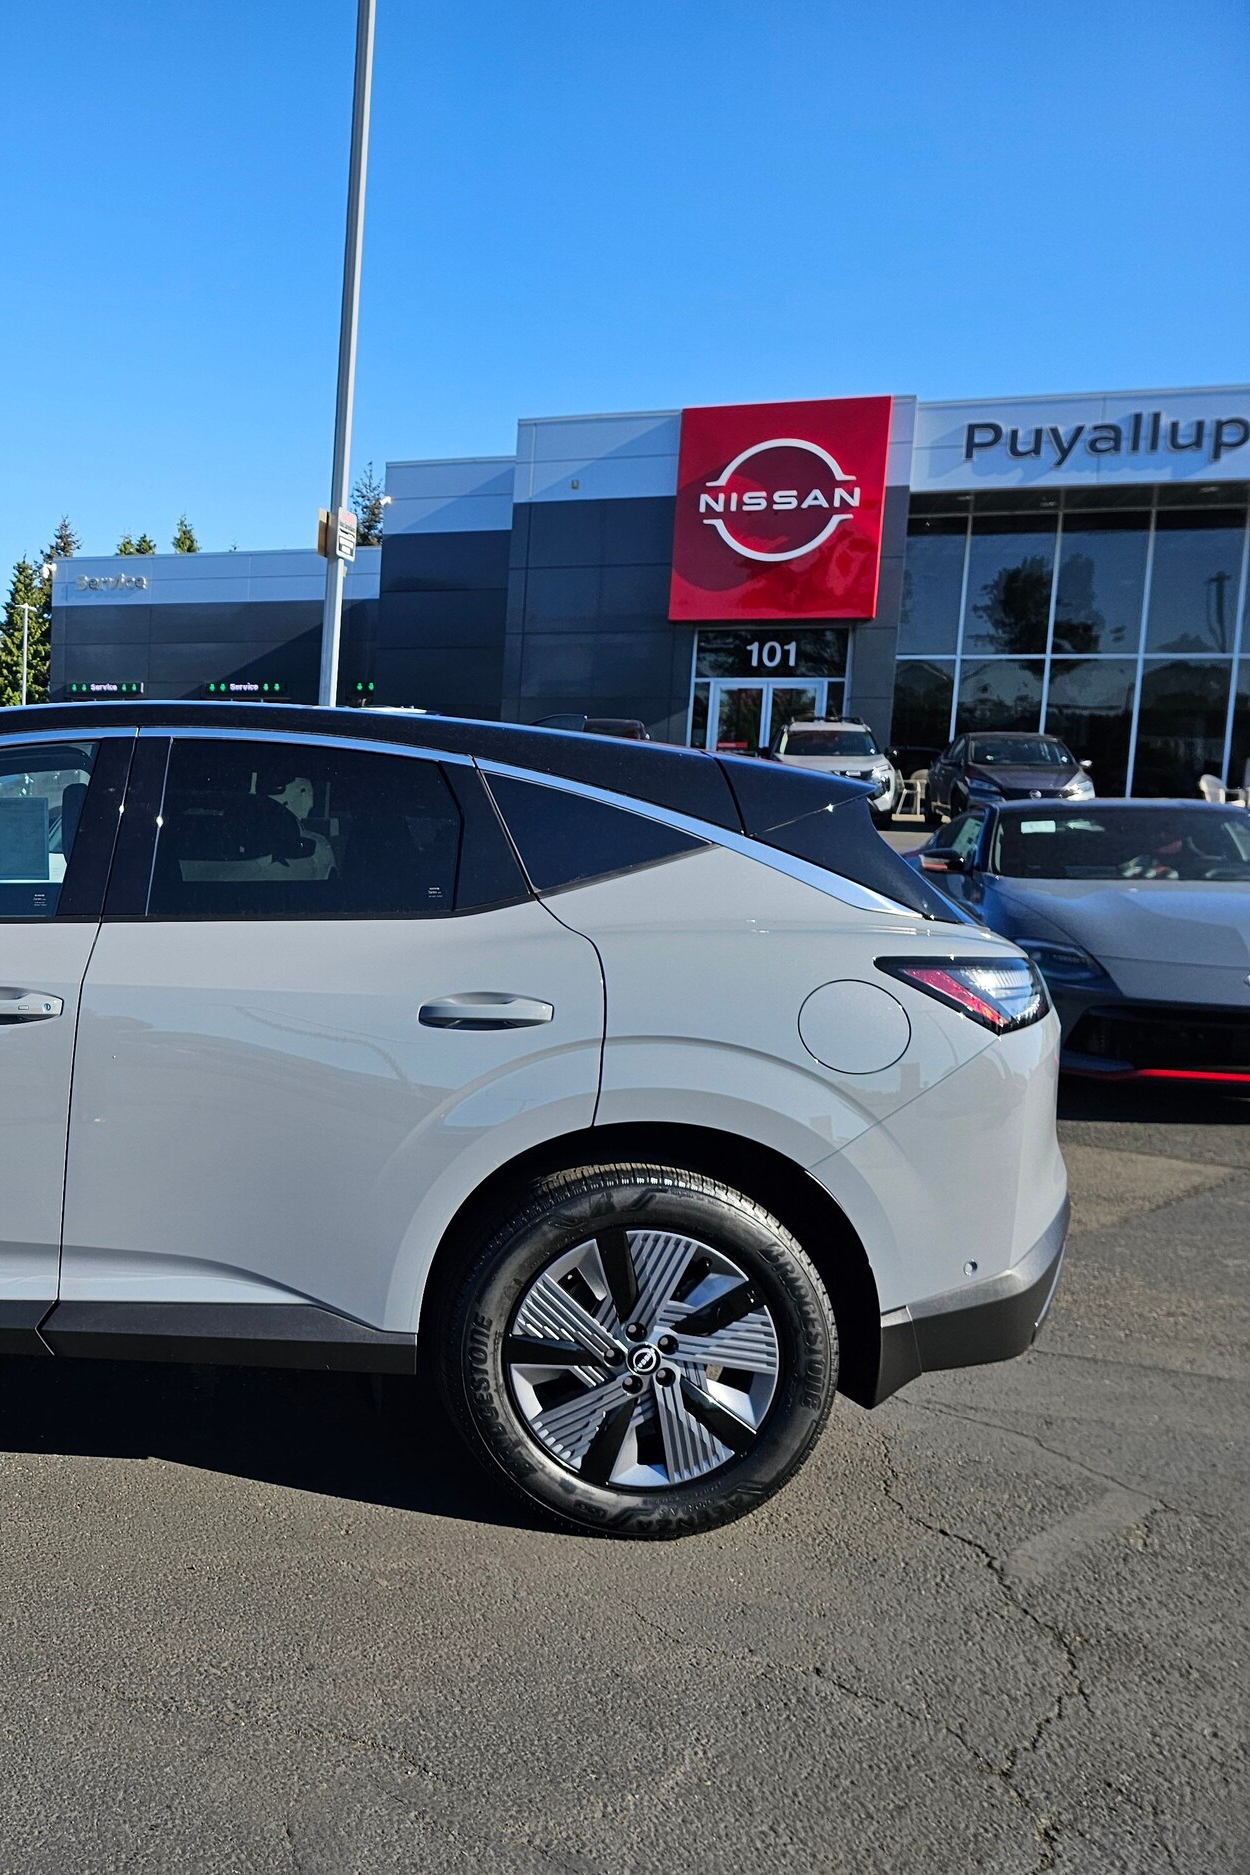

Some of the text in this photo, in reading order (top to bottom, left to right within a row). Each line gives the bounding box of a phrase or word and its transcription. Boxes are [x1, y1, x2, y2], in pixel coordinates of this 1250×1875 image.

[963, 411, 1250, 469] Puyallup
[699, 487, 861, 513] NISSAN
[76, 573, 148, 591] Service
[746, 641, 797, 668] 101
[90, 683, 118, 691] Service
[230, 682, 259, 691] Service
[756, 1244, 827, 1411] BRIDGESTONE
